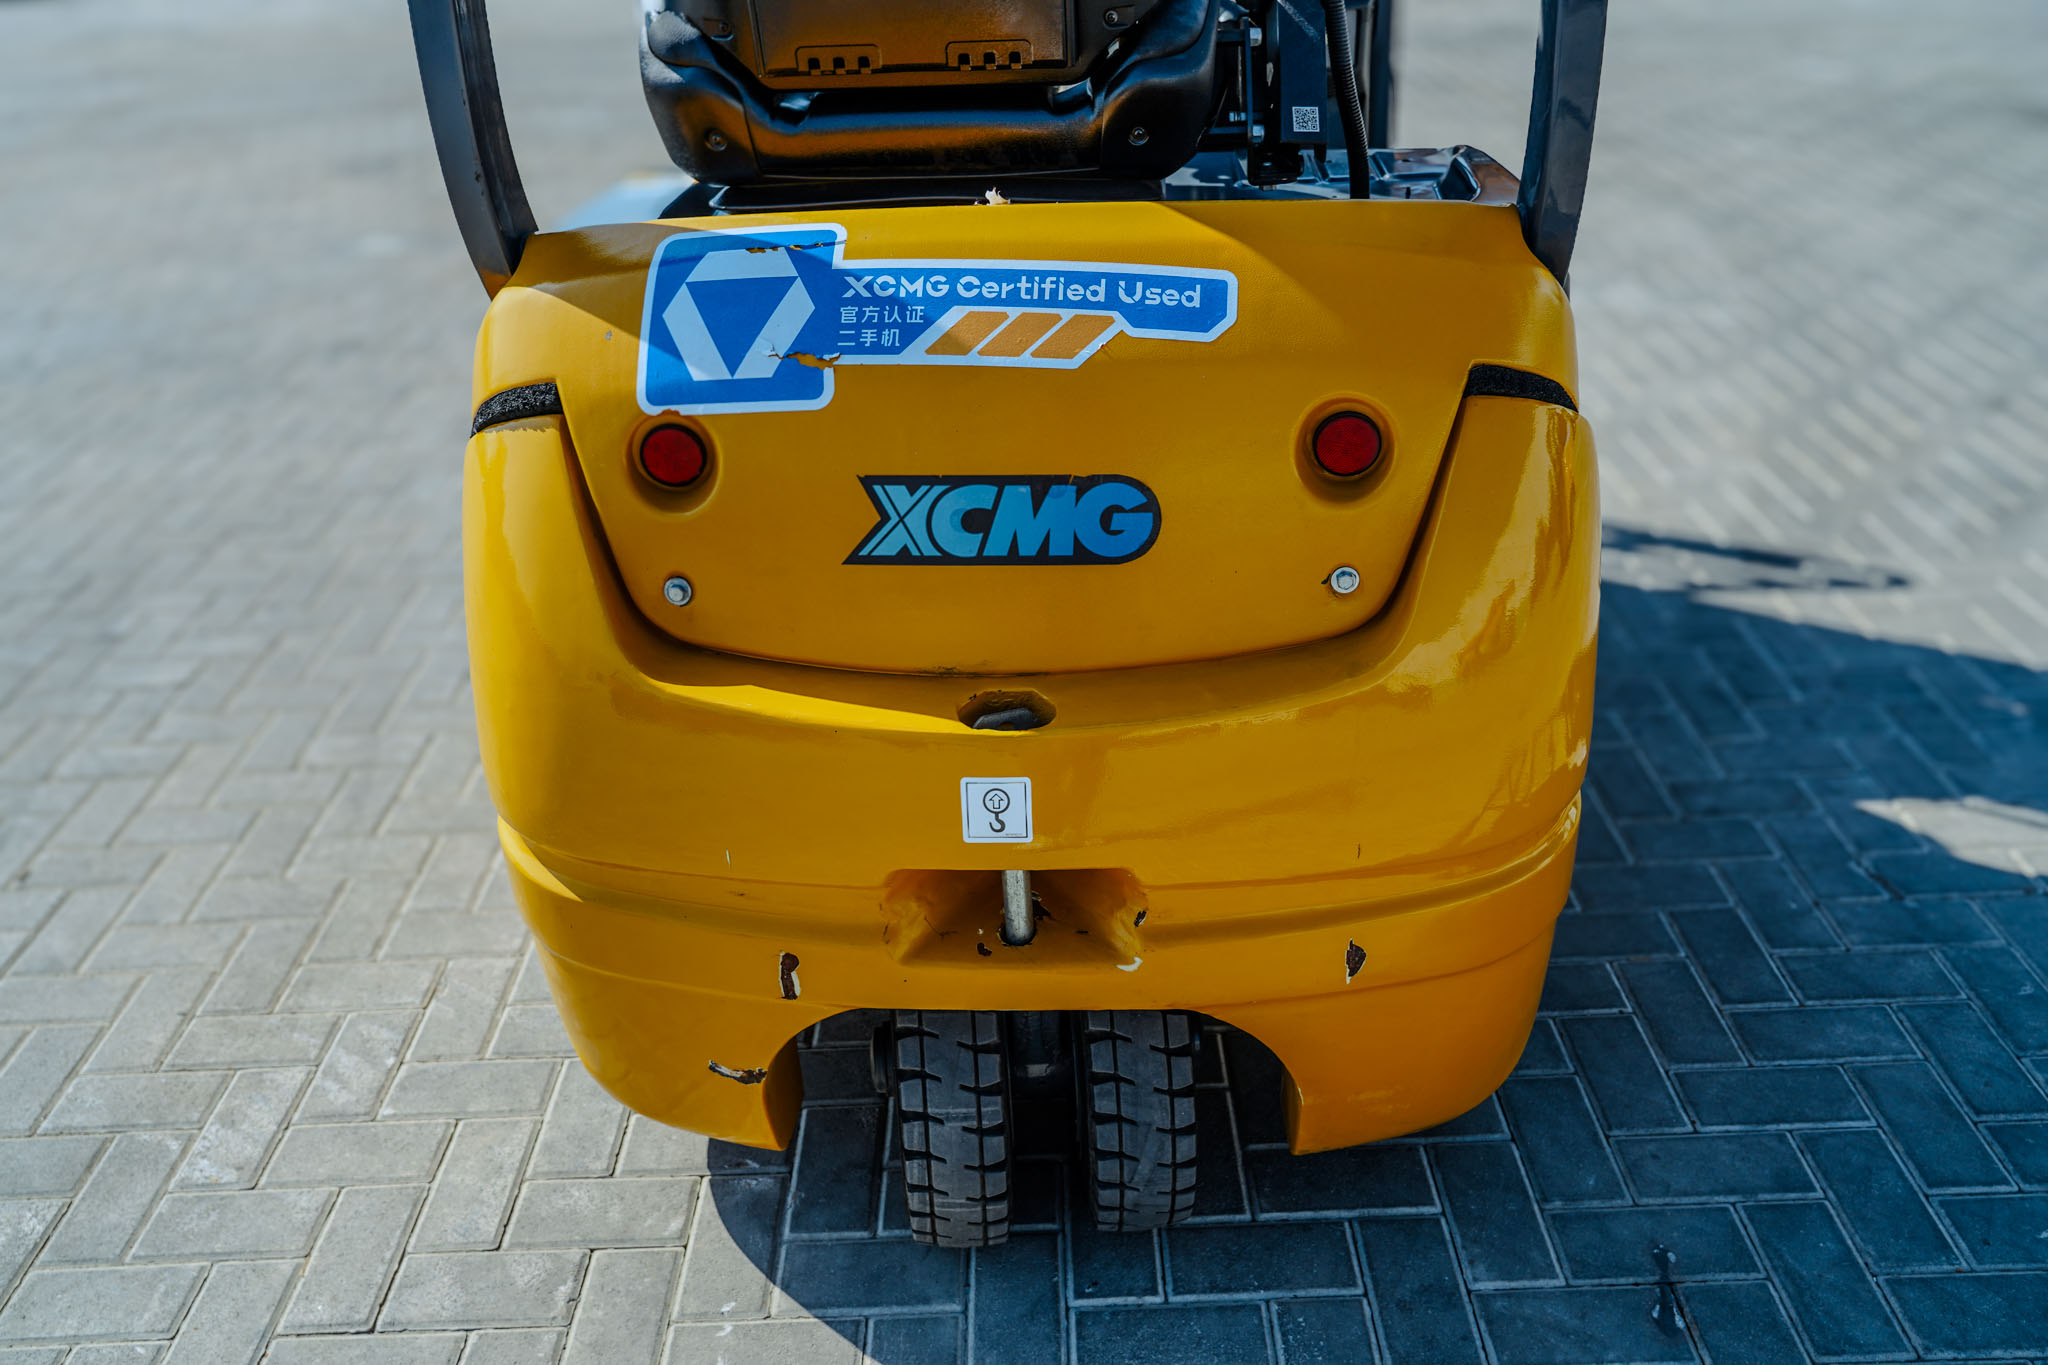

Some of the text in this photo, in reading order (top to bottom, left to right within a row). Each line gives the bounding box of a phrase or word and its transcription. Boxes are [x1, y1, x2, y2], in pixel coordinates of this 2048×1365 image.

[842, 275, 1201, 308] XCMG Certified Used
[840, 305, 925, 324] 官方认证
[837, 328, 901, 347] 二手机
[858, 482, 1154, 558] XCMG
